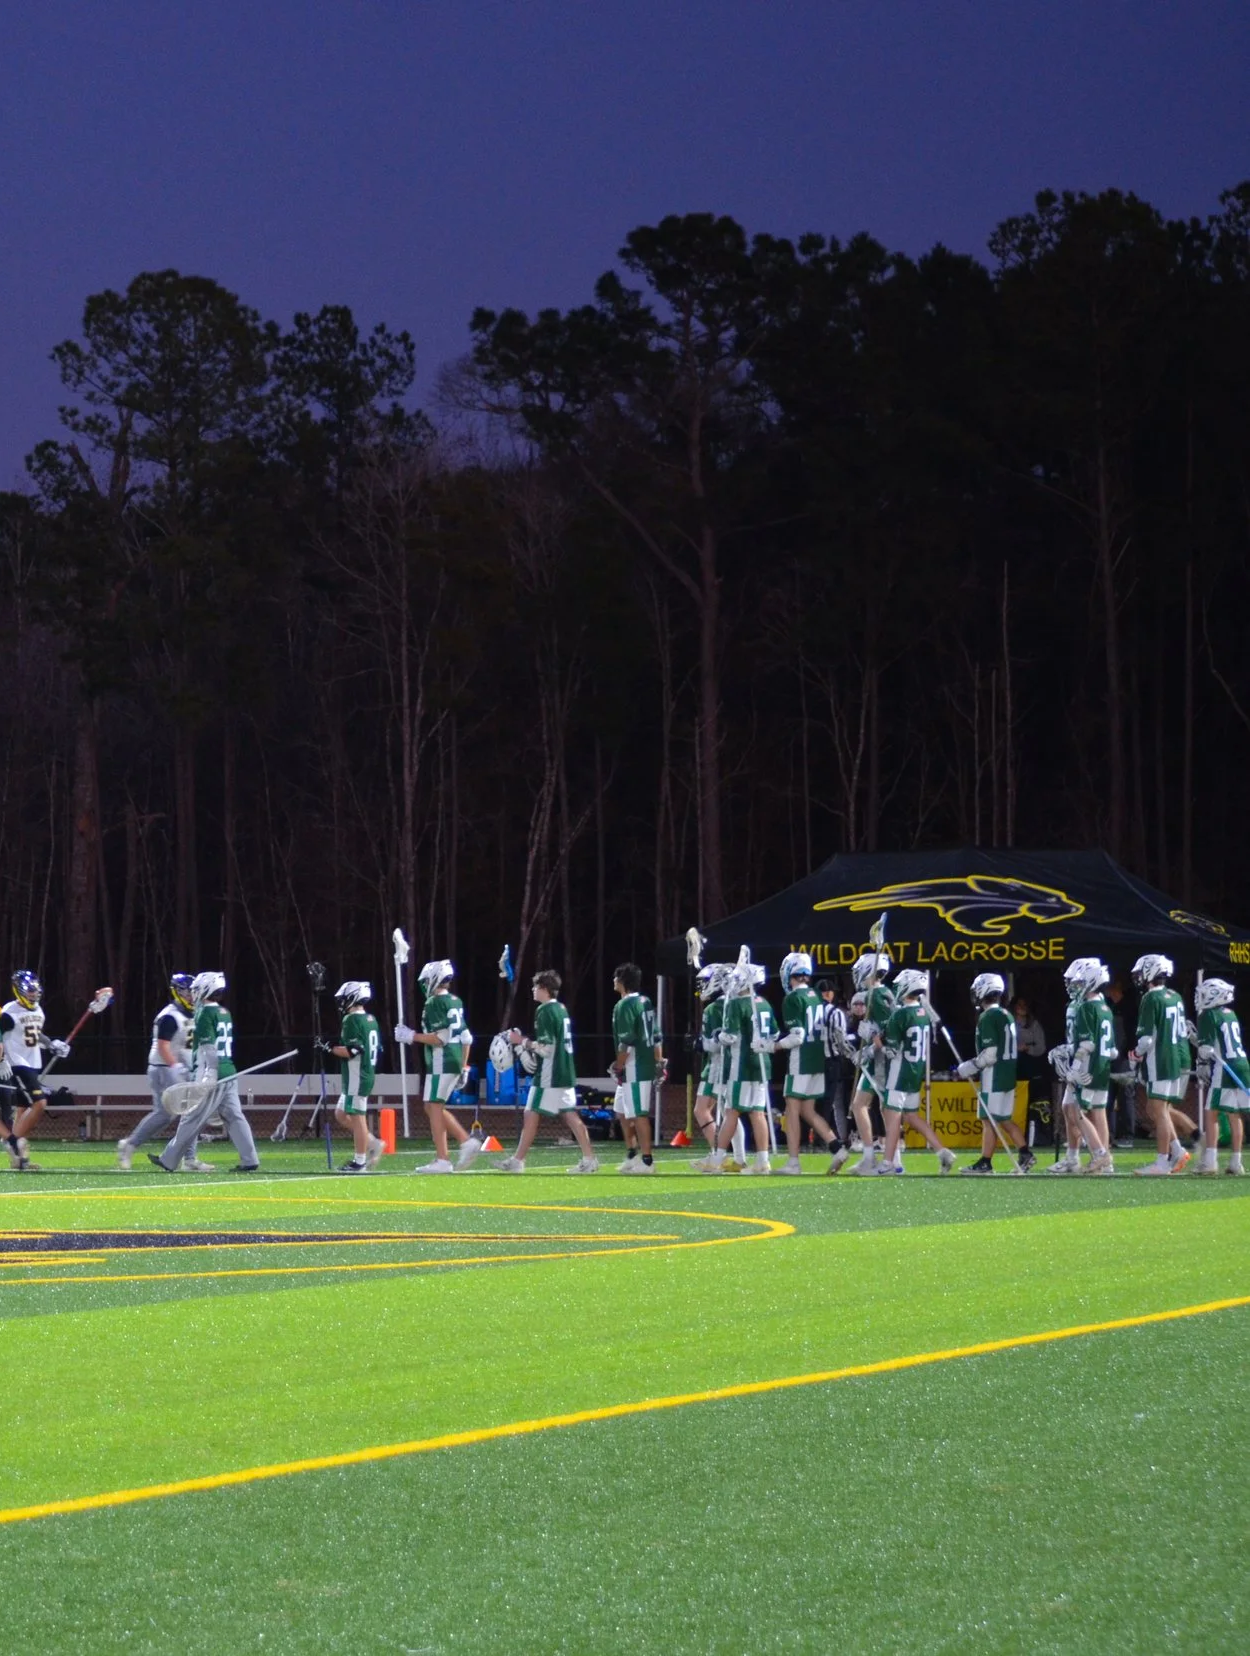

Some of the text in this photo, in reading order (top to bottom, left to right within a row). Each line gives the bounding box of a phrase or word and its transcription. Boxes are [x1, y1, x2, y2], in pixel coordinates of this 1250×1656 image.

[917, 938, 1065, 963] LACROSSE
[447, 1008, 464, 1044] 2
[1166, 1001, 1187, 1044] 76
